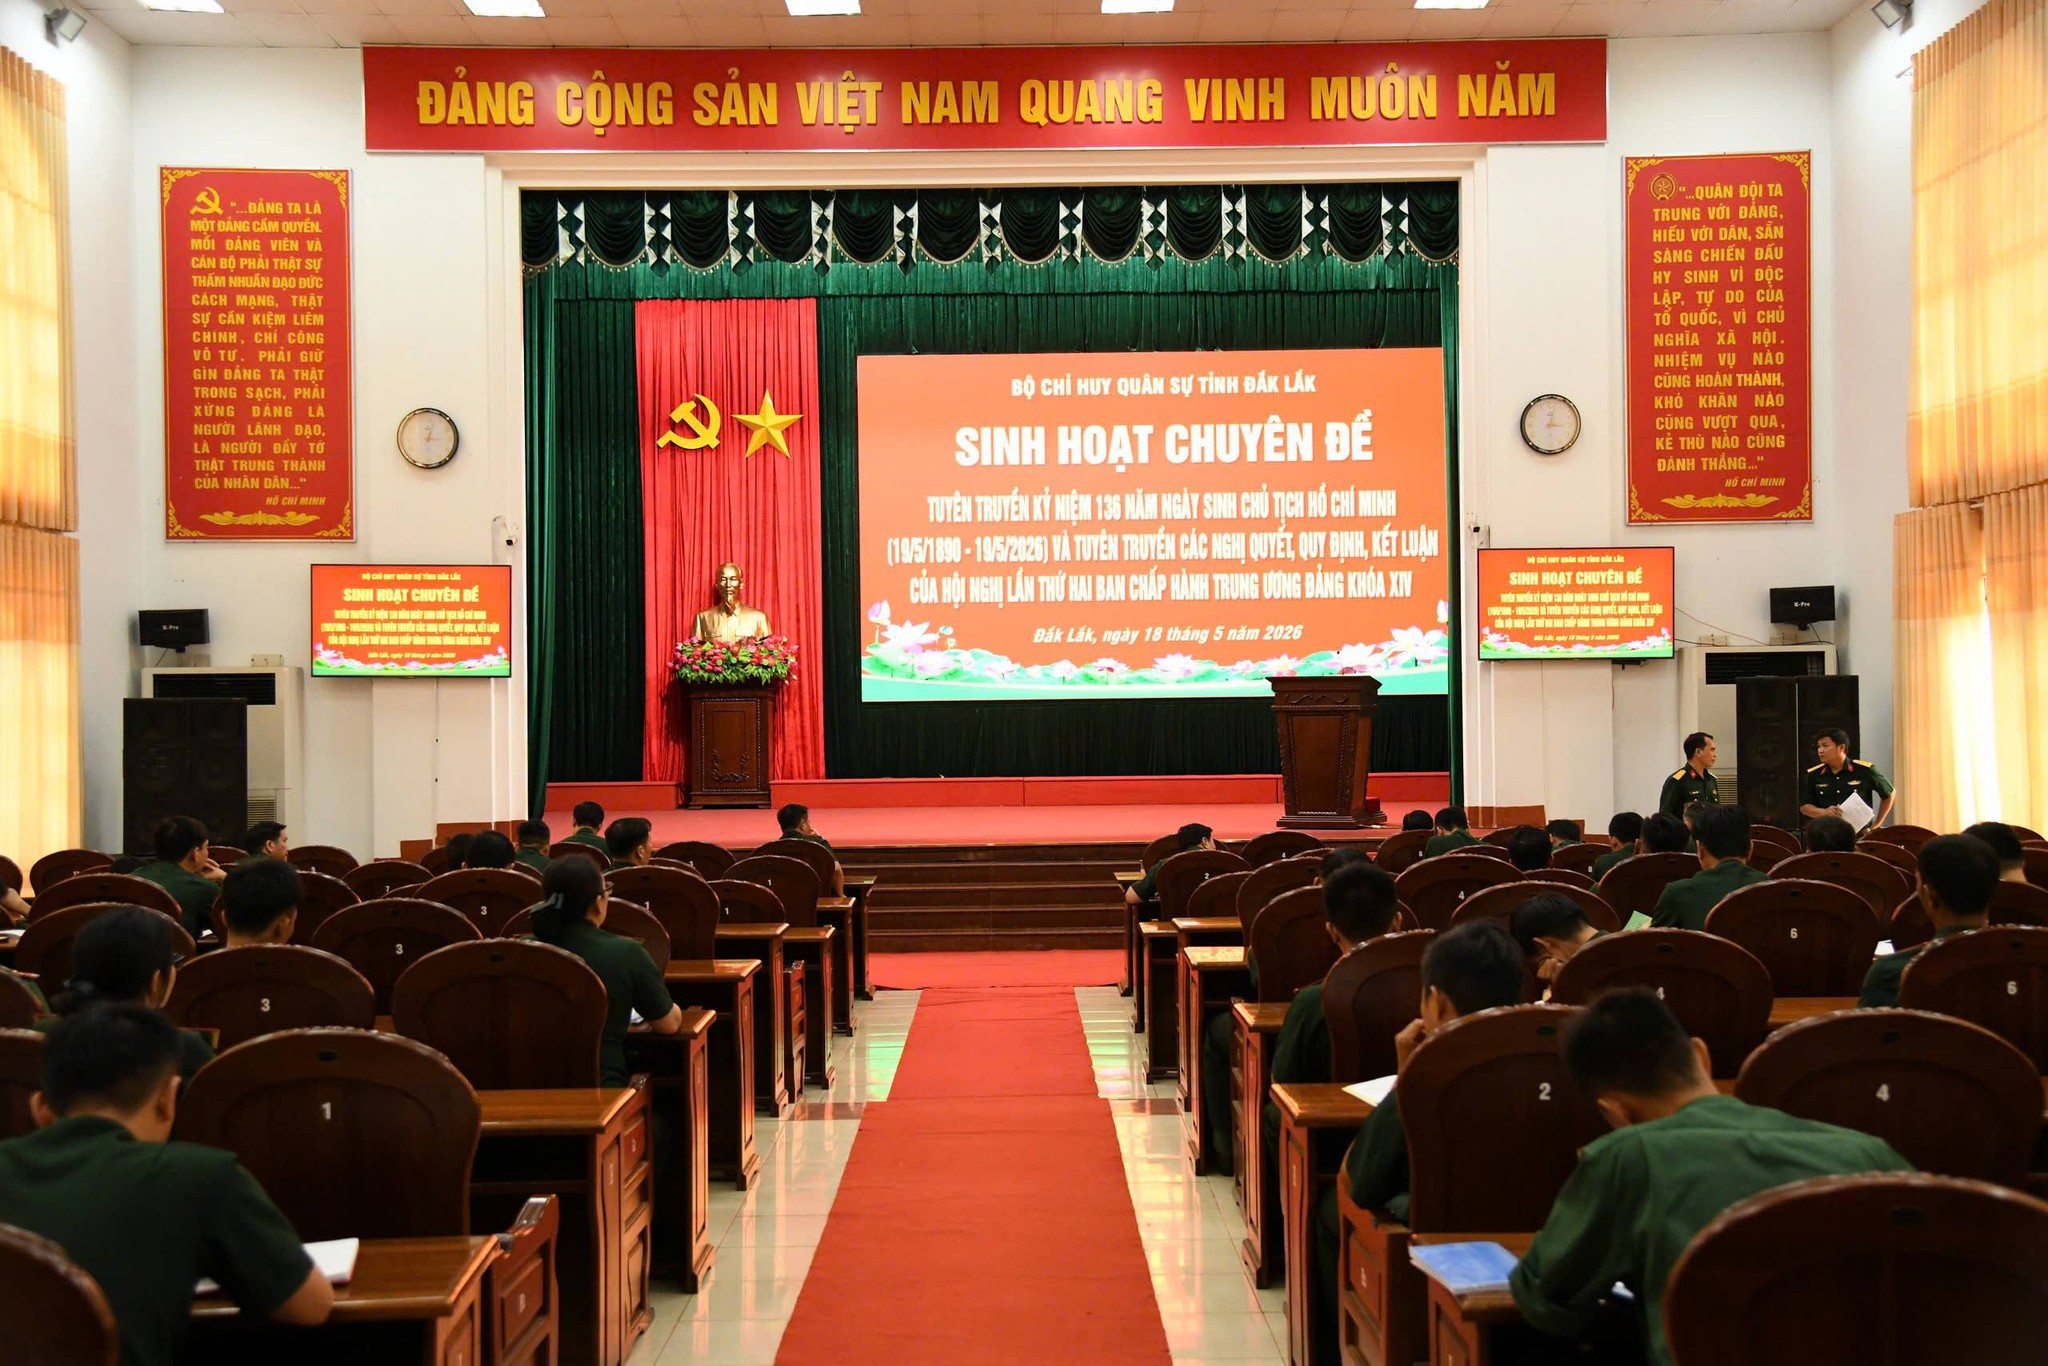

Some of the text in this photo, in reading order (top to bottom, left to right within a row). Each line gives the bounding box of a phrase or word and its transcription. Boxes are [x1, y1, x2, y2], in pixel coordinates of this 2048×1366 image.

[417, 60, 1556, 136] ĐẢNG CỘNG SẢN VIỆT NAM QUANG VINH MUÔN NĂM
[1740, 181, 1762, 200] ĐỘI
[1768, 183, 1782, 196] TA
[288, 202, 301, 214] TA
[306, 201, 321, 214] LÀ
[1654, 243, 1783, 263] SÀNG CHIẾN ĐẤU
[192, 254, 322, 273] CÁN BỘ PHẢI THẬT SỰ
[1653, 266, 1784, 284] HY SINH VÌ ĐỘC
[192, 292, 323, 309] CÁCH MẠNG, THẬT
[1653, 285, 1783, 308] LẬP, TỰ DO CỦA
[1654, 350, 1784, 370] NHIỆM VỤ NÀO
[1011, 369, 1316, 399] BỘ CHỈ HUY QUÂN SỰ TỈNH ĐẮK LẮK
[1654, 371, 1784, 388] CŨNG HOÀN THÀNH,
[194, 384, 325, 401] TRONG SẠCH, PHẢI
[1654, 391, 1784, 409] KHÓ KHĂN NÀO
[194, 403, 235, 416] XỨNG
[309, 404, 324, 417] LÀ
[194, 421, 325, 438] NGƯỜI LÃNH ĐẠO,
[955, 409, 1373, 472] SINH HOẠT CHUYÊN ĐỀ
[1656, 433, 1673, 450] KẺ
[1679, 434, 1704, 449] THÙ
[1747, 433, 1785, 448] CŨNG
[194, 458, 325, 474] THẬT TRUNG THÀNH
[1657, 456, 1695, 471] ĐÁNH
[195, 474, 219, 488] CỦA
[224, 475, 259, 488] NHÂN
[928, 482, 1396, 526] TUYÊN TRUYỀN KỶ NIỆM 136 NĂM NGÀY SINH CHỦ TỊCH HỒ CHÍ MINH
[888, 522, 1438, 565] (19/5/1890 19/5/2026) VÀ TUYÊN TRUYỀN CÁC NGHỊ QUYẾT, QUY ĐỊNH, KẾT LUẬN
[910, 564, 1412, 608] CỦA HỘI NGHỊ LẦN THỨ HAI BAN CHẤP HÀNH TRUNG ƯƠNG ĐẢNG KHÓA XIV
[1509, 567, 1642, 587] SINH HOẠT CHUYÊN ĐỀ
[344, 585, 479, 604] SINH HOẠT CHUYÊN ĐỀ
[1033, 625, 1303, 645] Đắk Lắk, ngày 18 tháng 5 năm 2026
[1457, 891, 1465, 900] 4
[480, 906, 488, 916] 3
[644, 901, 651, 910] 1
[1790, 928, 1797, 939] 6
[396, 944, 403, 954] 3
[1656, 987, 1665, 1000] 4
[2007, 981, 2017, 995] 6
[261, 998, 270, 1012] 3
[1539, 1082, 1551, 1100] 2
[1876, 1083, 1889, 1101] 4
[321, 1102, 331, 1120] 1
